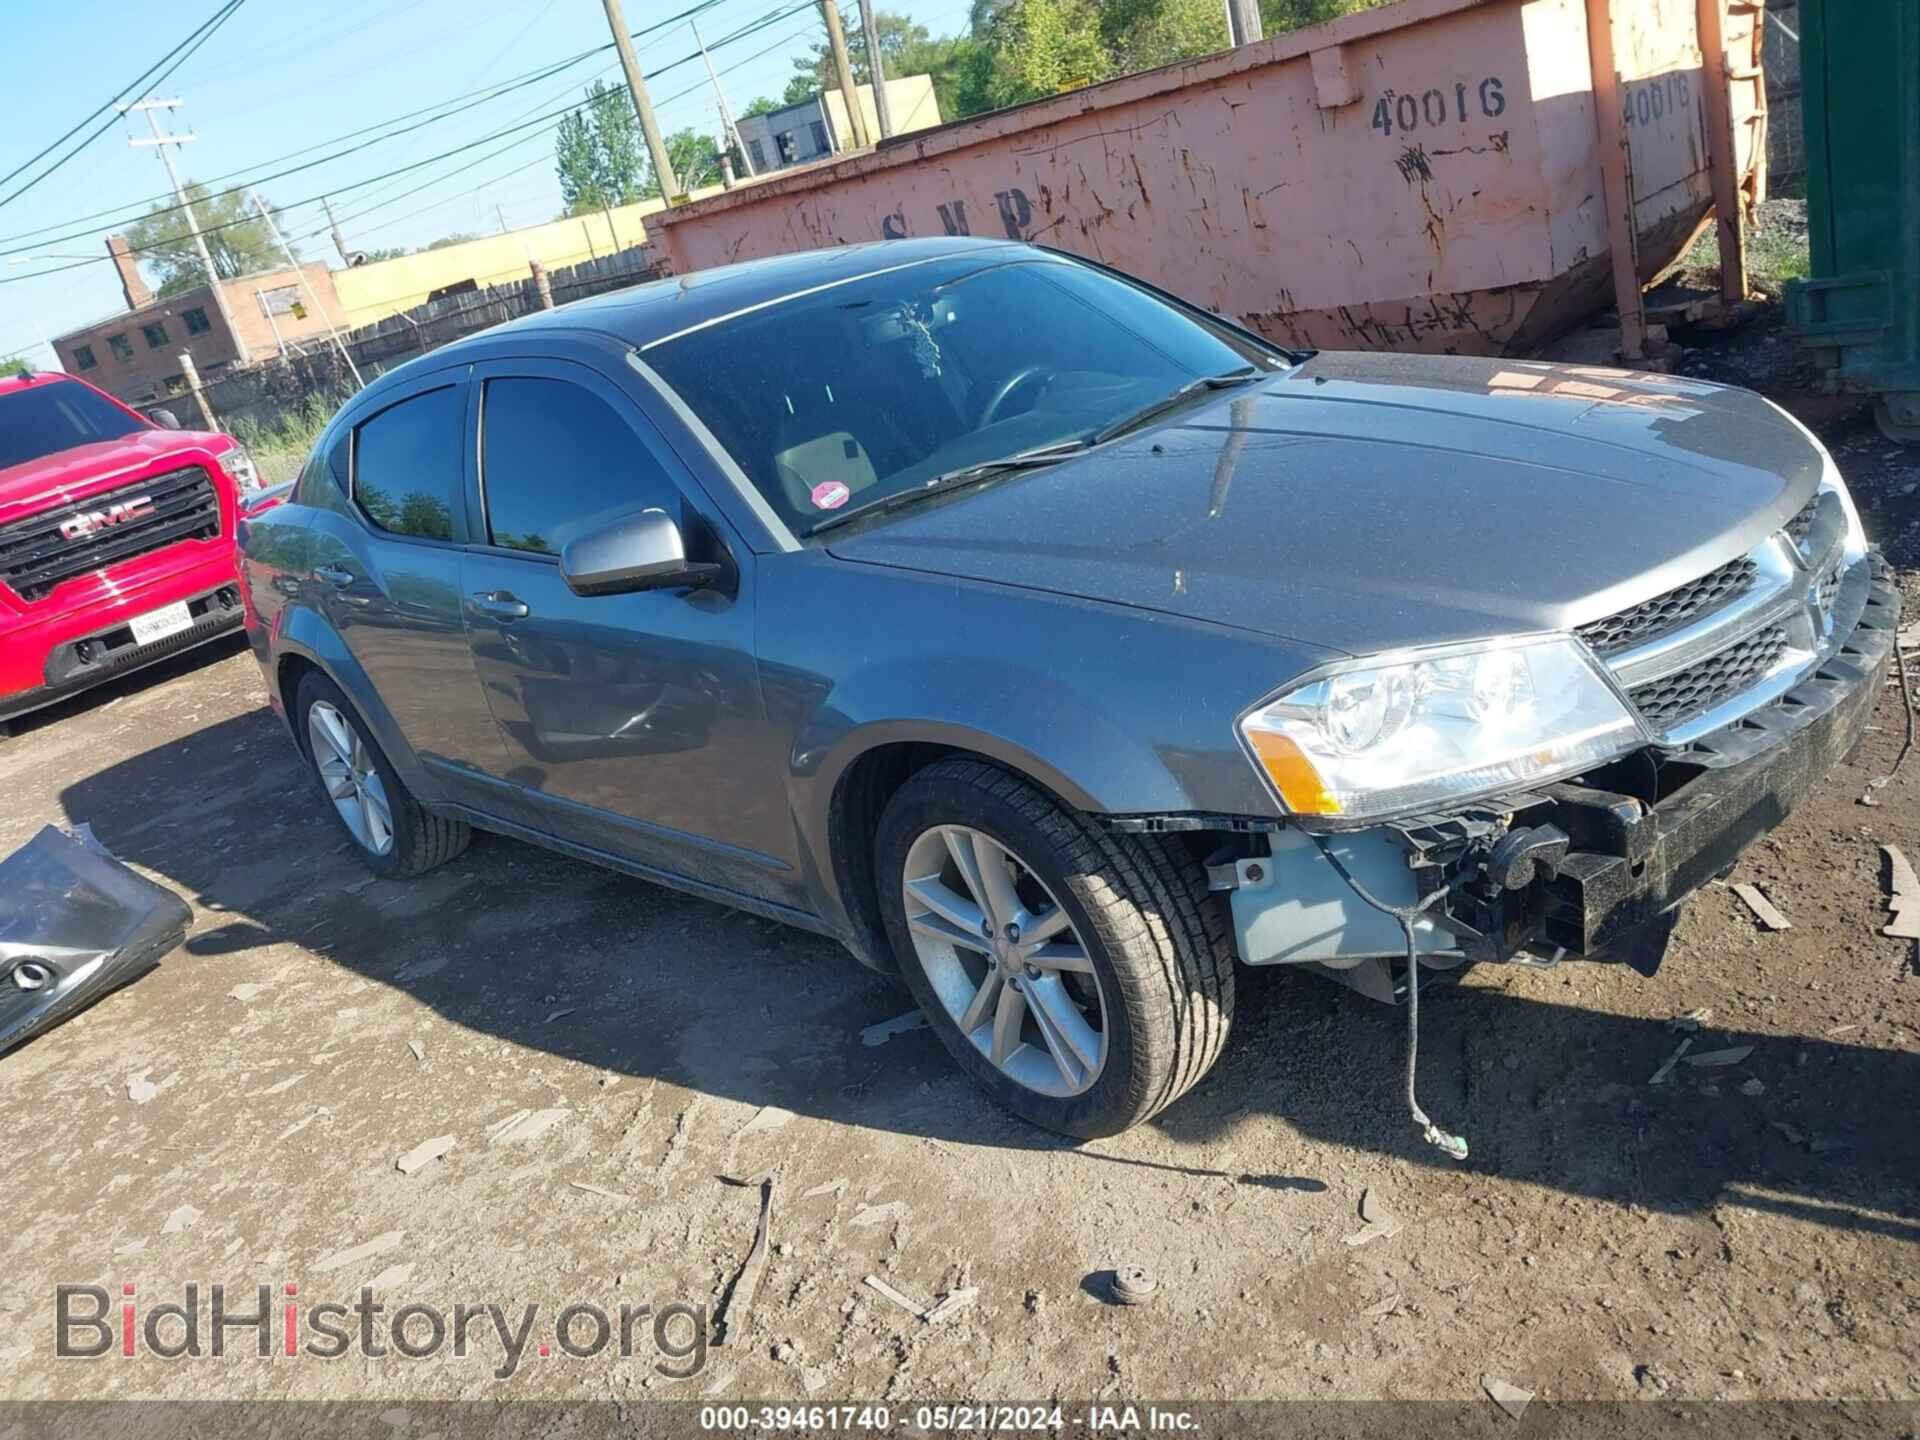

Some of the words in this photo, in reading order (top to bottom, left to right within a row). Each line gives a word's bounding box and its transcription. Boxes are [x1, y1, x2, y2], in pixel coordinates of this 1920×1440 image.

[1372, 77, 1506, 136] 40016
[1623, 74, 1689, 128] 40016
[60, 497, 155, 539] GMC
